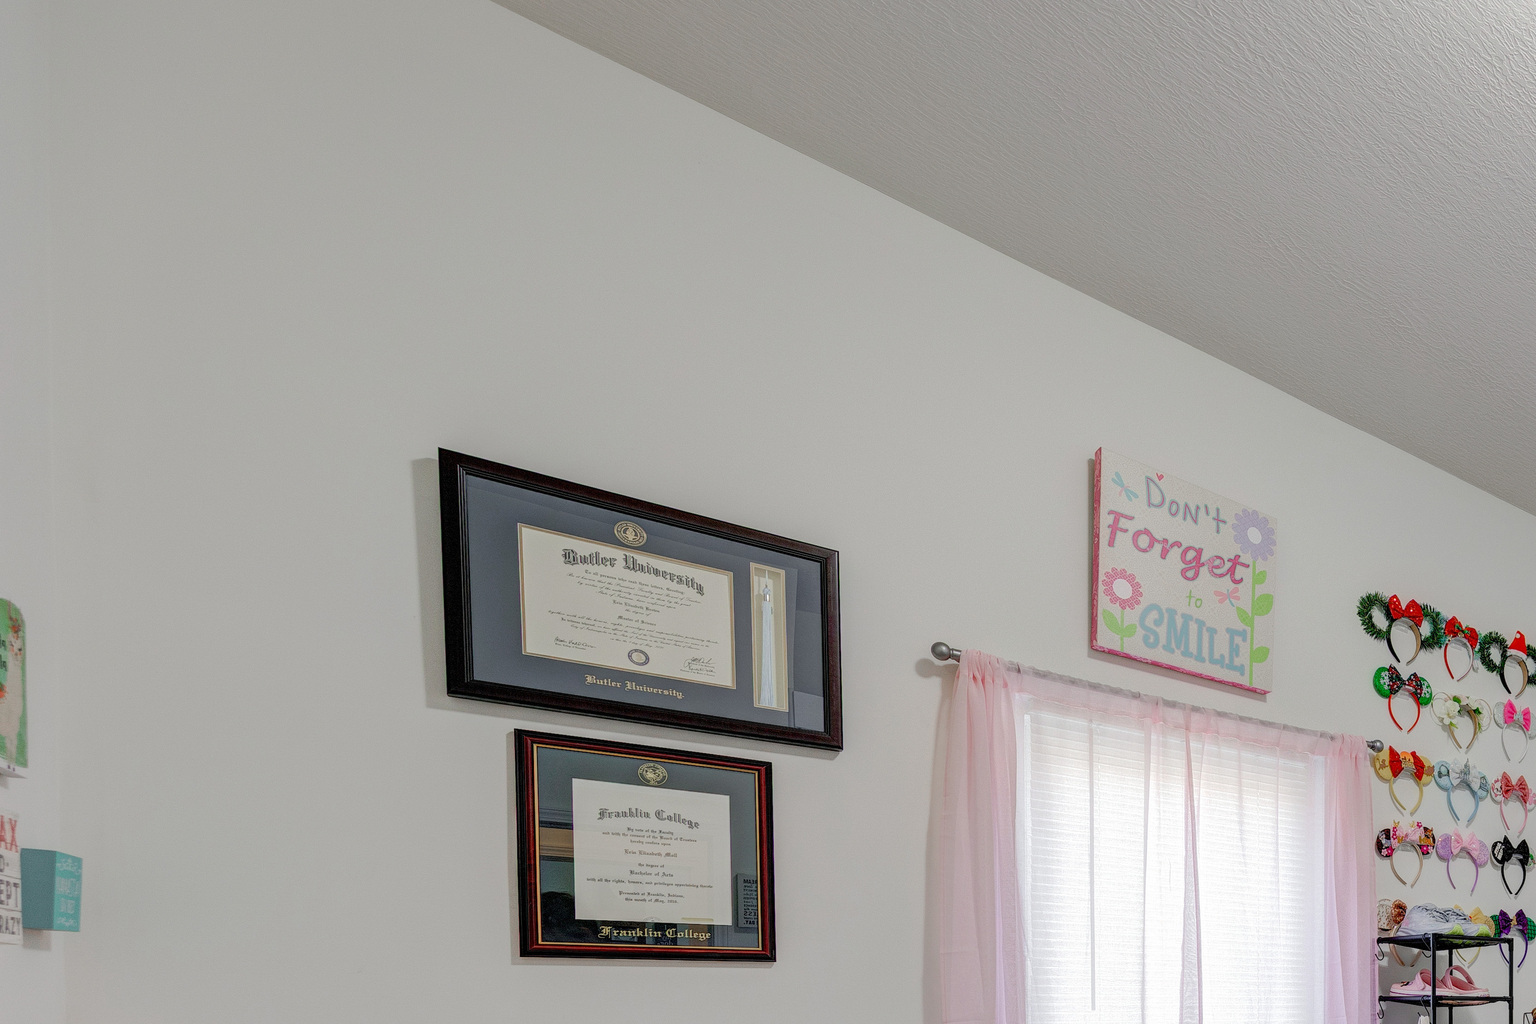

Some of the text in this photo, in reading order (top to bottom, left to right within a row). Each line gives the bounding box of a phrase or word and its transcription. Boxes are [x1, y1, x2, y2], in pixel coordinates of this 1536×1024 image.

[1107, 509, 1250, 585] Forget
[562, 549, 617, 567] Butler
[623, 553, 705, 596] University
[1186, 589, 1202, 609] to
[1139, 603, 1248, 676] SMILE
[584, 674, 622, 688] Butler
[597, 807, 700, 829] Franklin College
[597, 925, 711, 941] Franklin College
